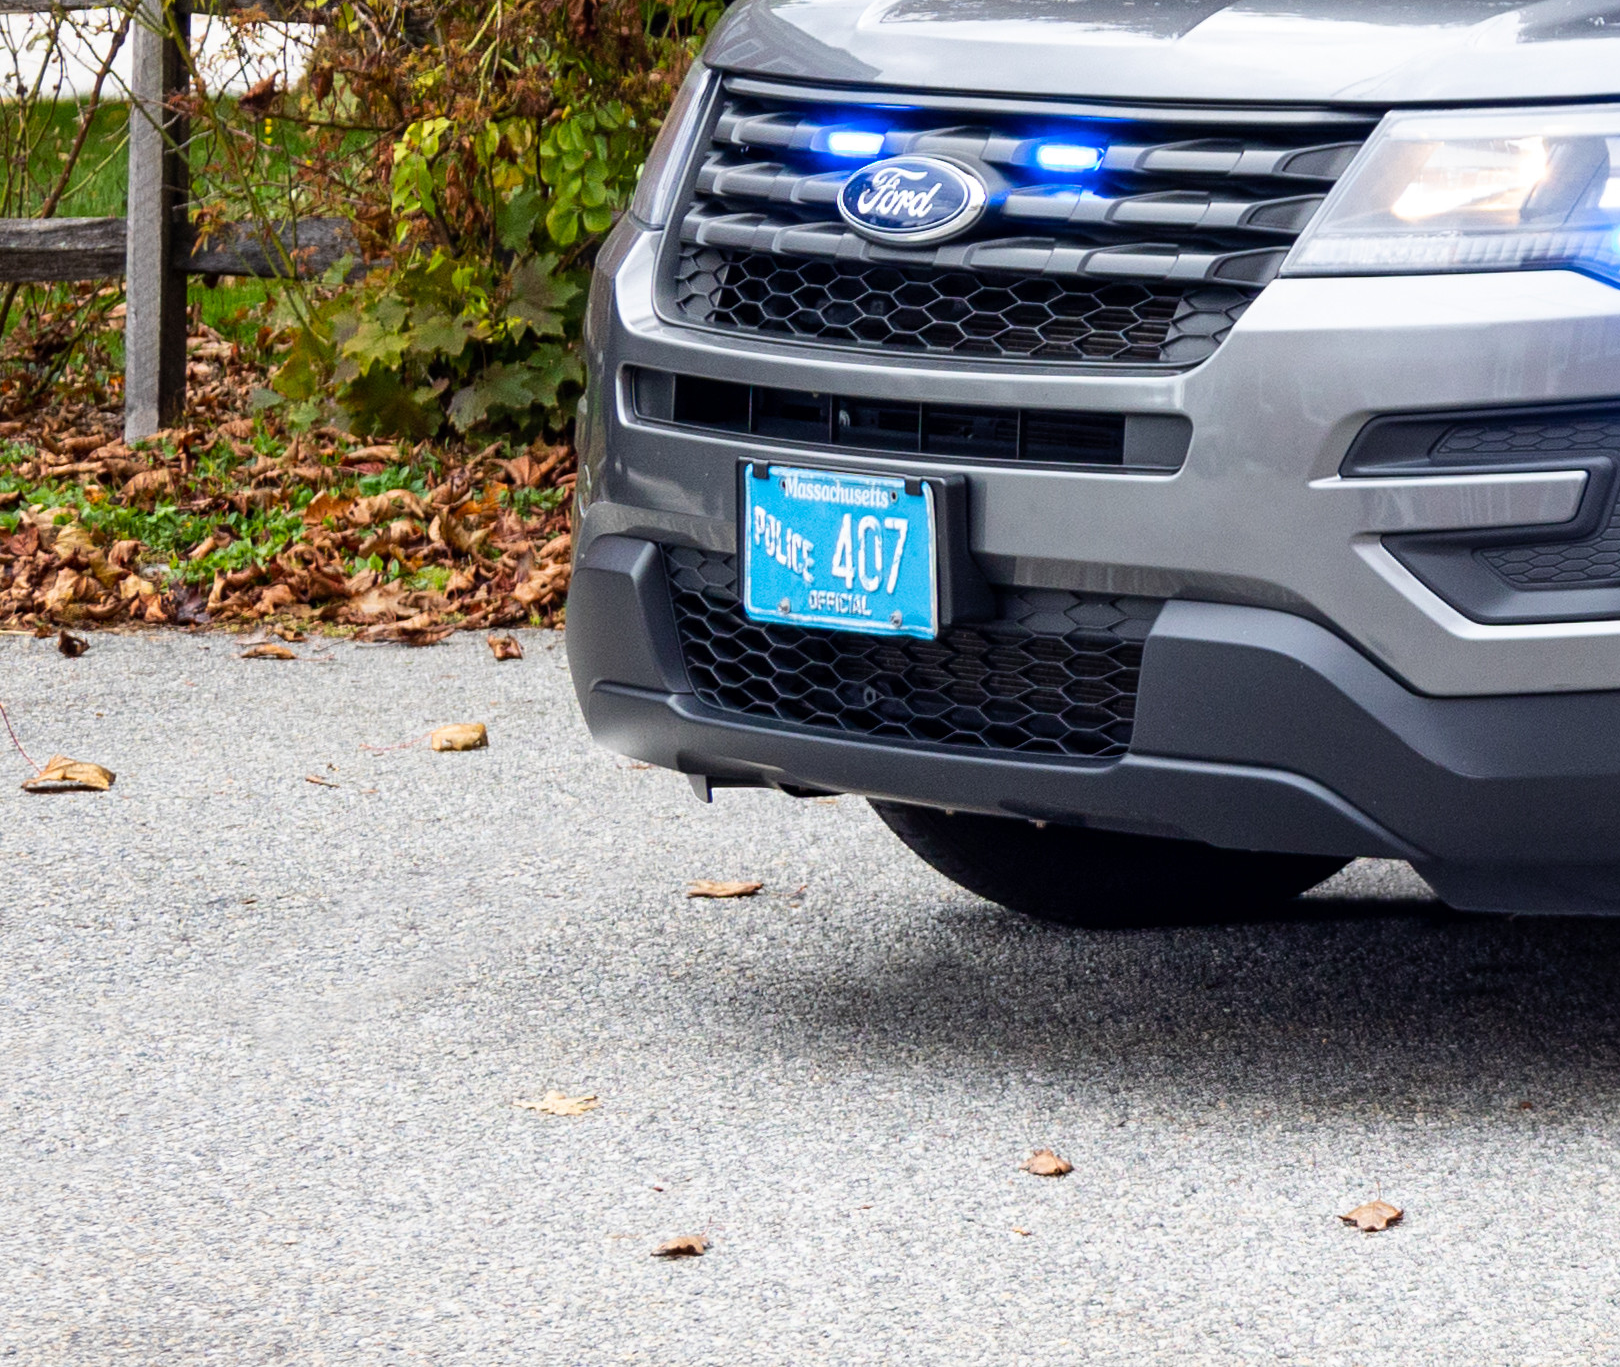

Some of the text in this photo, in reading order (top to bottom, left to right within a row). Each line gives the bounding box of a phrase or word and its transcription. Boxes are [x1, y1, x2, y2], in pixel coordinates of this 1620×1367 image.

[857, 167, 943, 219] Ford
[785, 475, 889, 509] Massachusetts
[754, 505, 908, 595] POLICE 407
[808, 589, 872, 616] OFFICIAL
